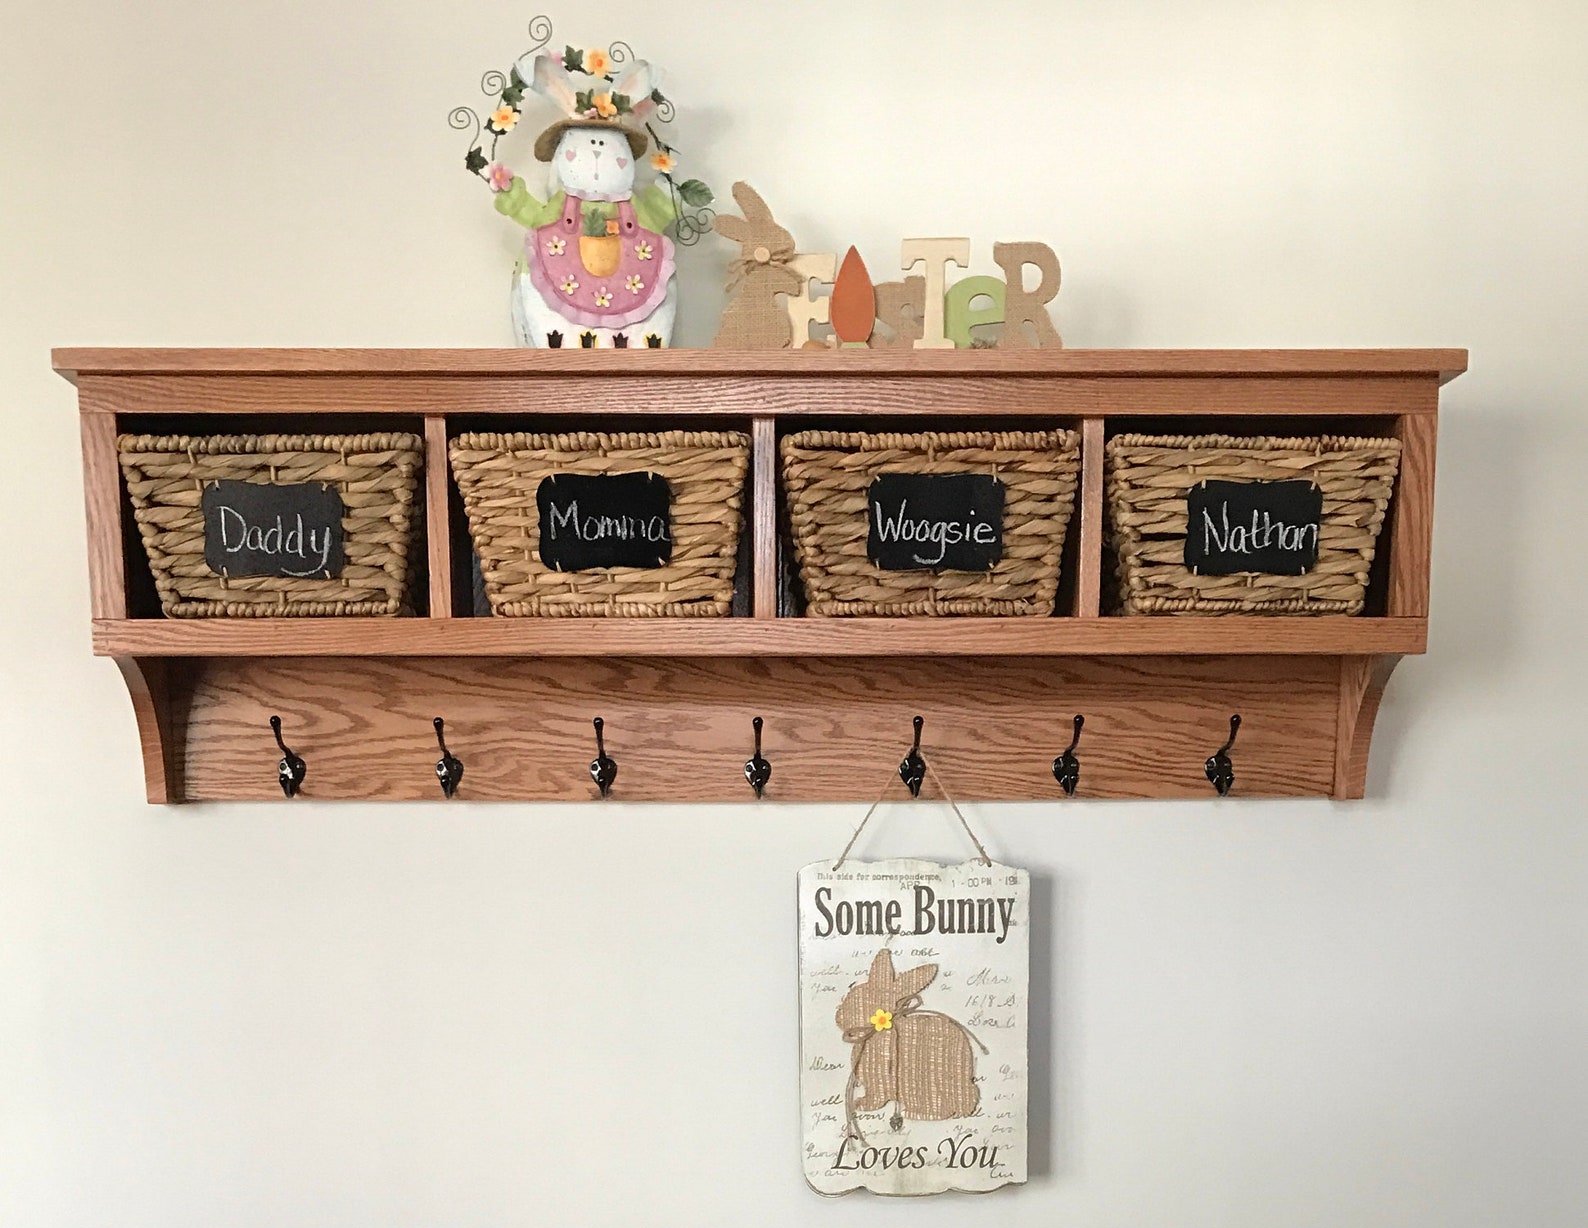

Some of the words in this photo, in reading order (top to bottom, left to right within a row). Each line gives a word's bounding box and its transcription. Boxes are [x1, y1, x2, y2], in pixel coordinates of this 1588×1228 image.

[217, 505, 332, 577] Daddy
[550, 500, 672, 542] Momma
[875, 499, 997, 564] Woogsie
[1202, 500, 1318, 556] Nathan
[817, 872, 833, 880] This
[837, 872, 853, 880] side
[856, 872, 870, 880] for
[814, 886, 902, 937] Some
[914, 885, 1016, 944] Bunny
[831, 1135, 928, 1171] Loves
[937, 1133, 999, 1170] You
